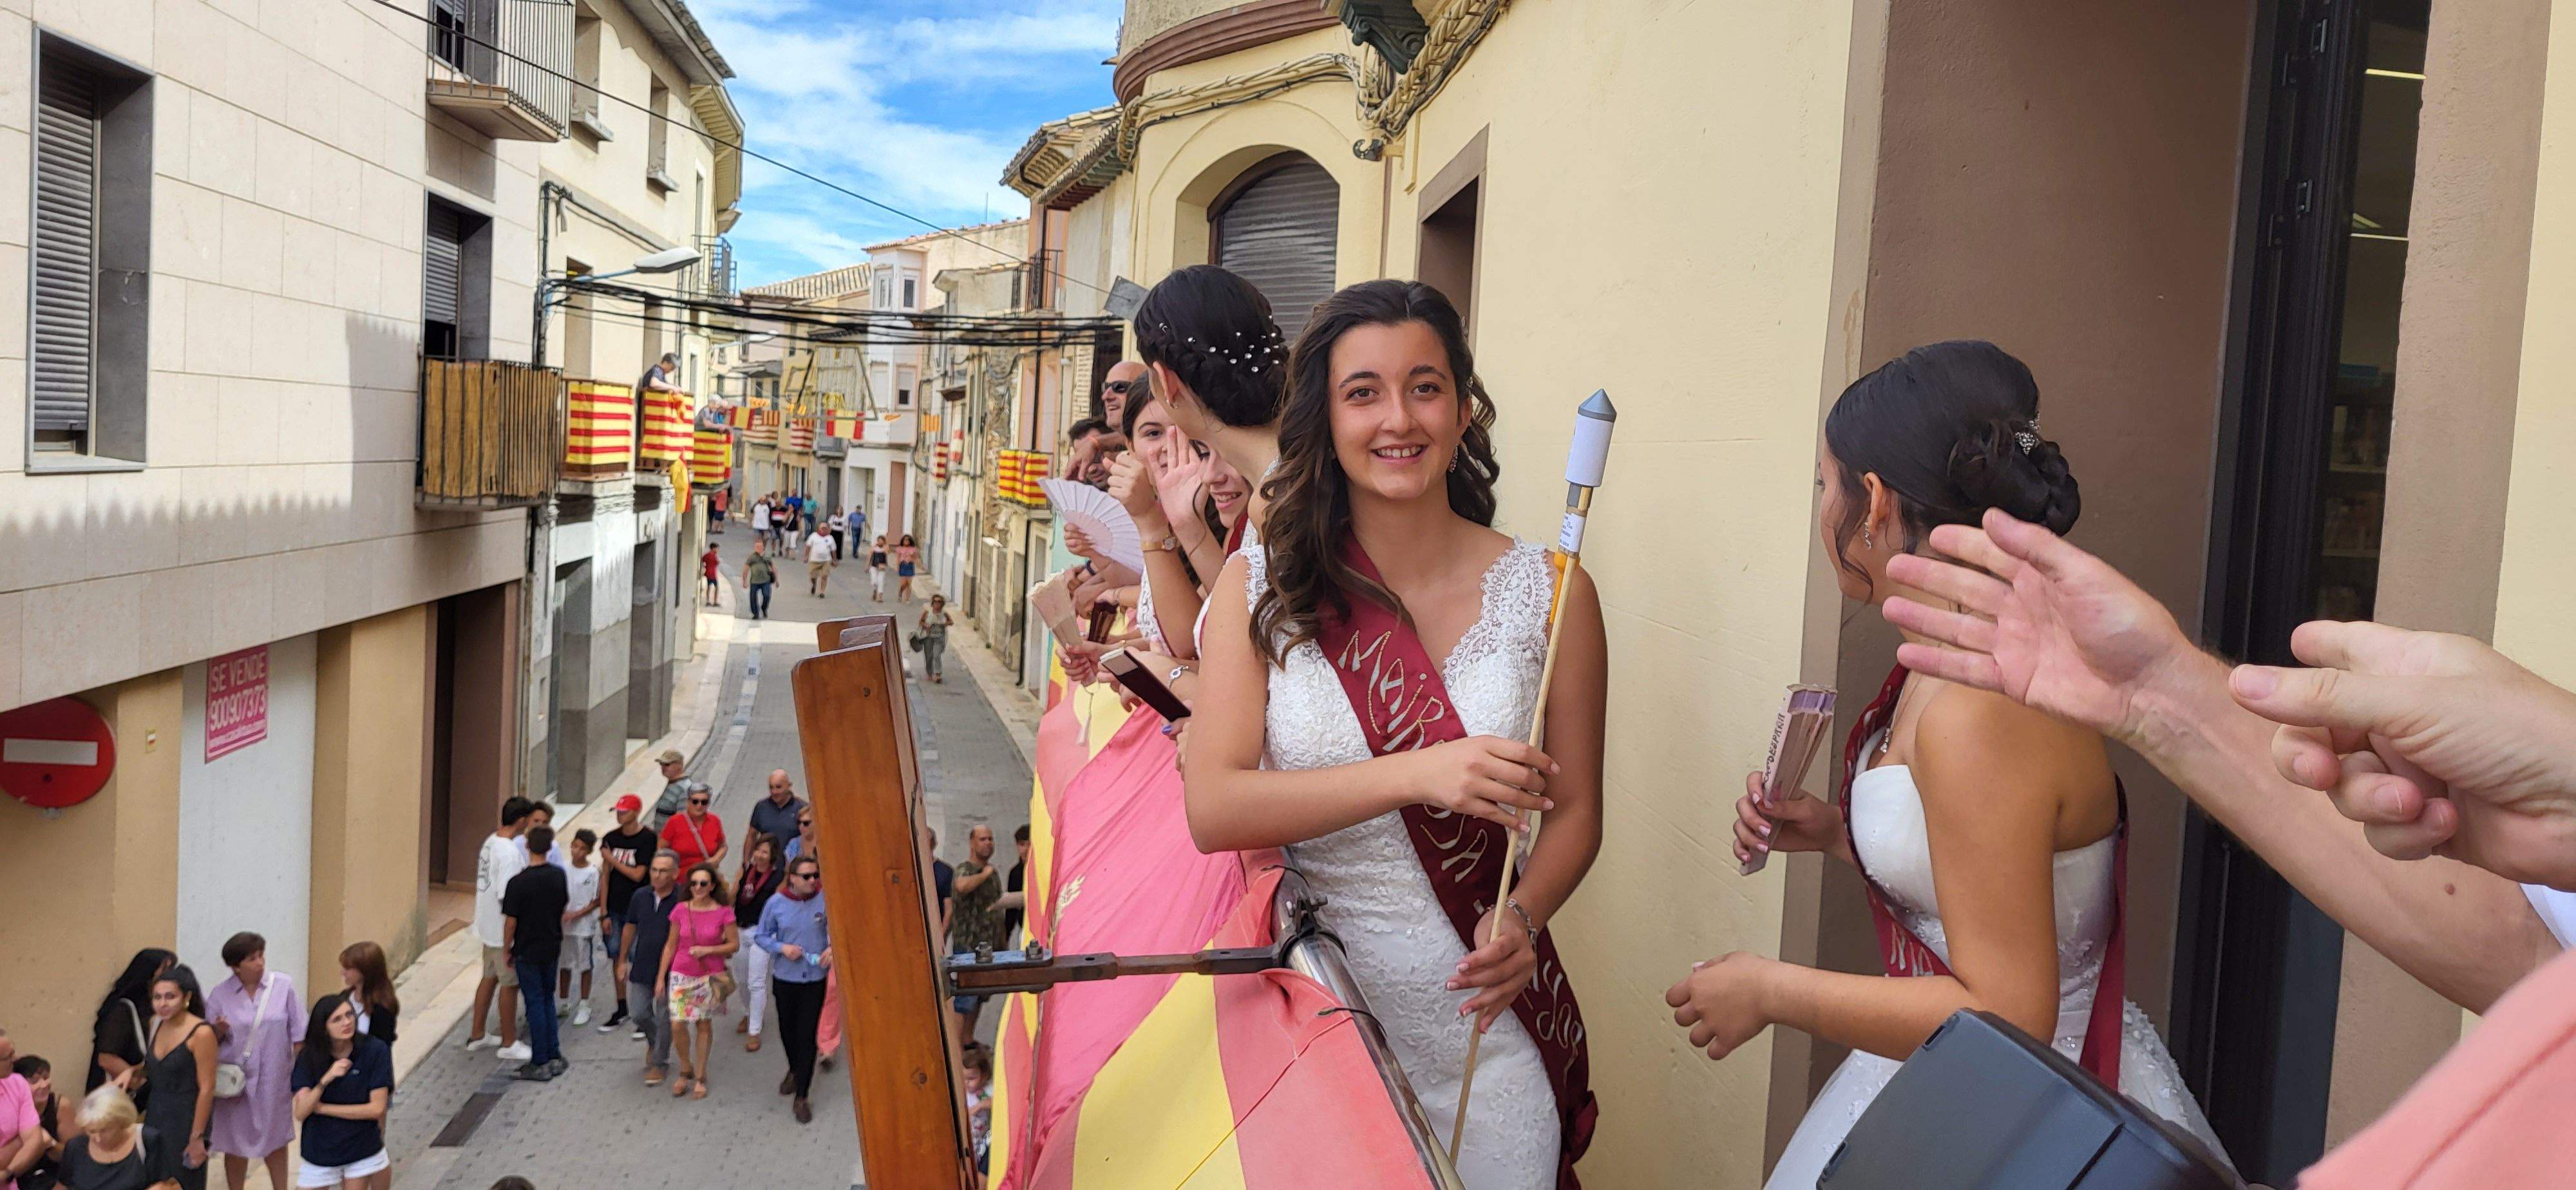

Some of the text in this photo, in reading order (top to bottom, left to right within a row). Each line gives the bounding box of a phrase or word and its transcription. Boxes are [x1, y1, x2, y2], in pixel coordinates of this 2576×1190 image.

[211, 652, 266, 693] SE VENDE
[211, 685, 266, 732] 900907373
